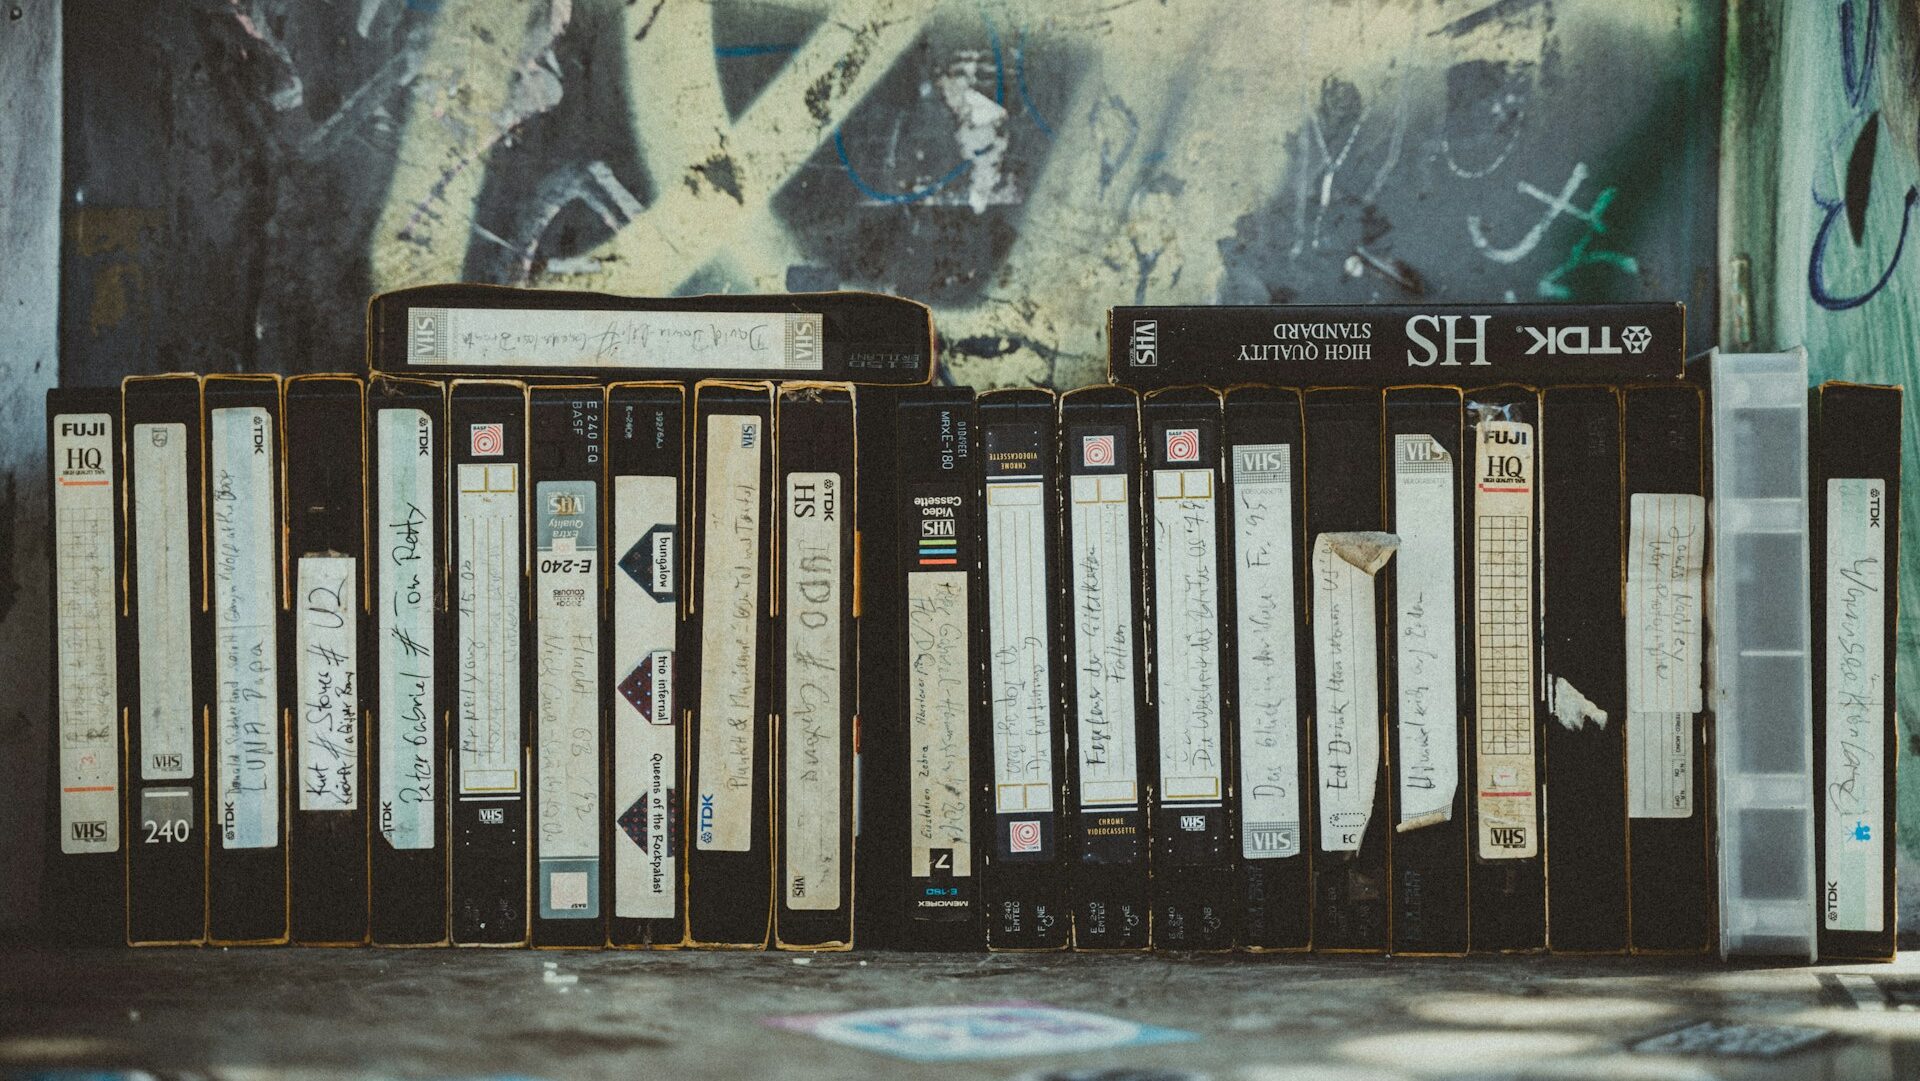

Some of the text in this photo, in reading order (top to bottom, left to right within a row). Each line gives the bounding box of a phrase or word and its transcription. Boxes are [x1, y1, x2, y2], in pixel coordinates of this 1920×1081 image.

[417, 316, 436, 356] VHS
[794, 321, 813, 361] VHS
[1273, 322, 1372, 339] STANDARD
[1405, 314, 1492, 367] HS
[1523, 326, 1623, 355] TDK
[1135, 322, 1156, 365] VHS
[1237, 341, 1372, 361] HIGH QUALITY
[62, 422, 105, 436] FUJI
[571, 401, 584, 436] BASF
[253, 425, 264, 455] TDK
[418, 426, 429, 457] TDK
[586, 400, 598, 463] E 240 EQ
[743, 425, 753, 447] VHS
[941, 410, 954, 470] MRXE-180
[1484, 431, 1527, 445] FUJI
[67, 447, 103, 471] HQ
[989, 452, 1038, 461] VIDEOCASSETTE
[1001, 462, 1027, 470] CHROME
[1243, 452, 1281, 471] VHS
[1486, 455, 1524, 479] HQ
[550, 496, 582, 514] VHS
[794, 483, 815, 519] HS
[824, 491, 834, 522] TDK
[914, 496, 962, 507] Cassette
[922, 507, 954, 517] Video
[1869, 498, 1881, 528] TDK
[549, 519, 583, 538] Extra Quality
[923, 521, 953, 535] VHS
[541, 559, 592, 573] E-240
[654, 537, 671, 588] bungalow
[657, 655, 670, 721] trio infernal
[154, 754, 181, 768] VHS
[242, 721, 274, 792] LUNA
[225, 801, 235, 831] TDK
[382, 801, 392, 832] TDK
[480, 810, 502, 820] VHS
[701, 793, 714, 831] TDK
[1182, 817, 1205, 828] VHS
[74, 823, 106, 838] VHS
[144, 819, 190, 844] 240
[649, 753, 665, 895] Queens of the Rockpalast
[1087, 826, 1136, 836] VIDEOCASSETTE
[1254, 832, 1291, 850] VHS
[1343, 834, 1357, 844] EC
[1492, 828, 1524, 844] VHS
[794, 876, 805, 898] VHS
[926, 887, 958, 895] E-180
[1827, 880, 1838, 911] TDK
[1004, 901, 1012, 921] 240
[1089, 902, 1098, 922] 240
